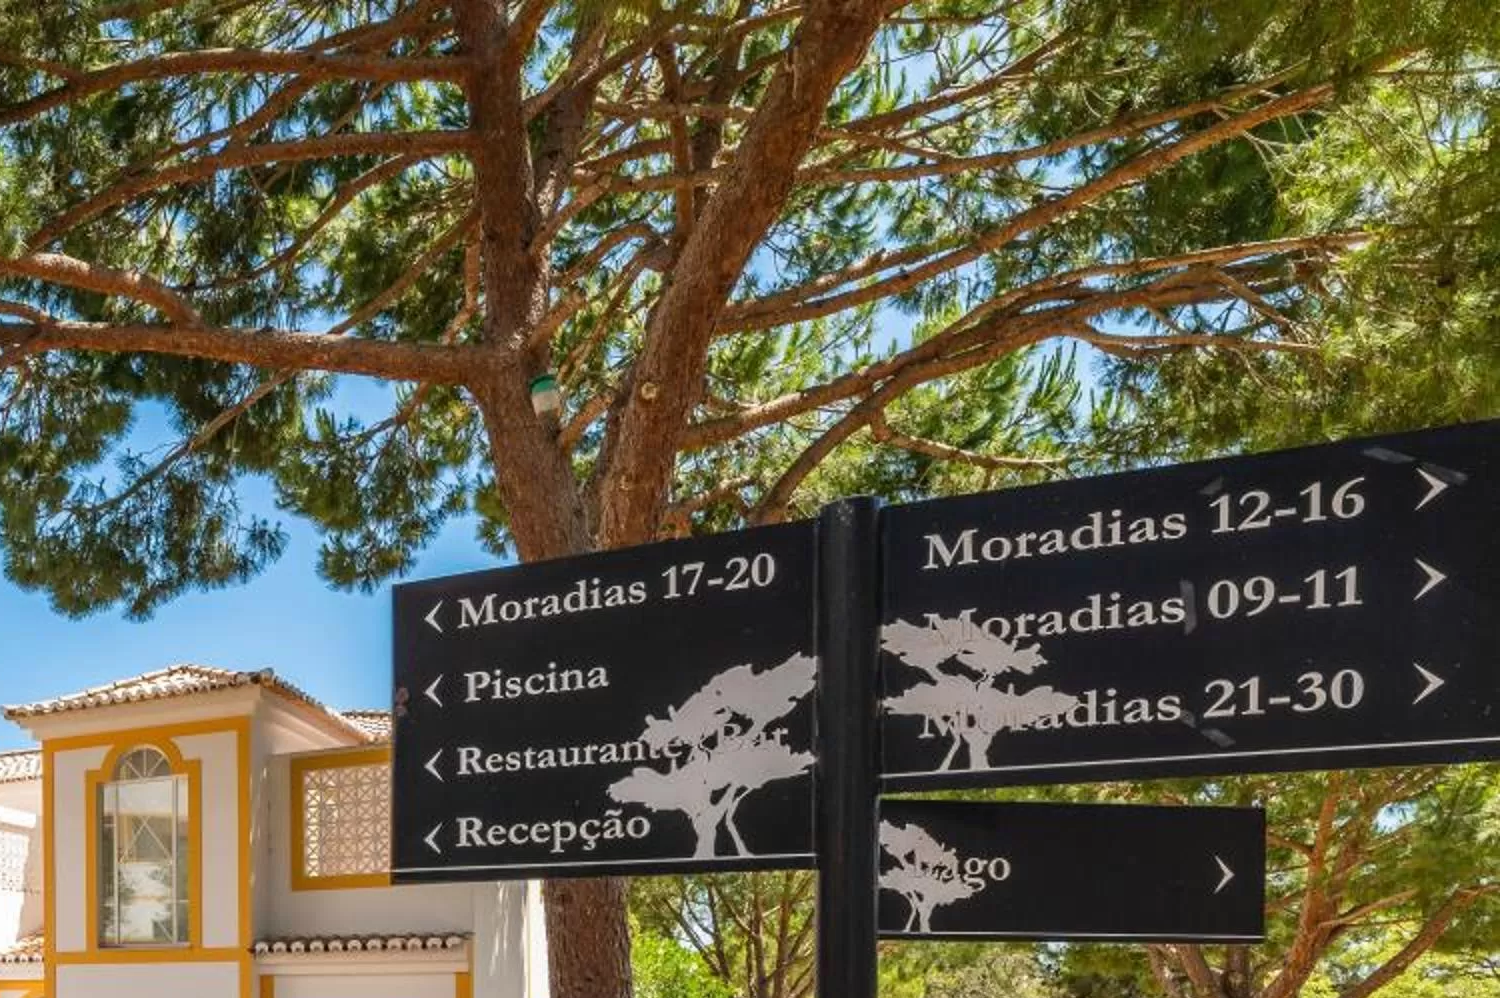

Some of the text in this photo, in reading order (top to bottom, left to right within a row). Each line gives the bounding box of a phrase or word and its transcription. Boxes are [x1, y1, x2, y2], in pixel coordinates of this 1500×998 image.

[923, 477, 1364, 569] Moradias 12-16
[457, 553, 774, 629] Moradias 17-20
[1208, 566, 1362, 618] 09-11
[464, 662, 609, 702] Piscina
[1204, 670, 1364, 718] 21-30
[456, 809, 651, 853] Recepção
